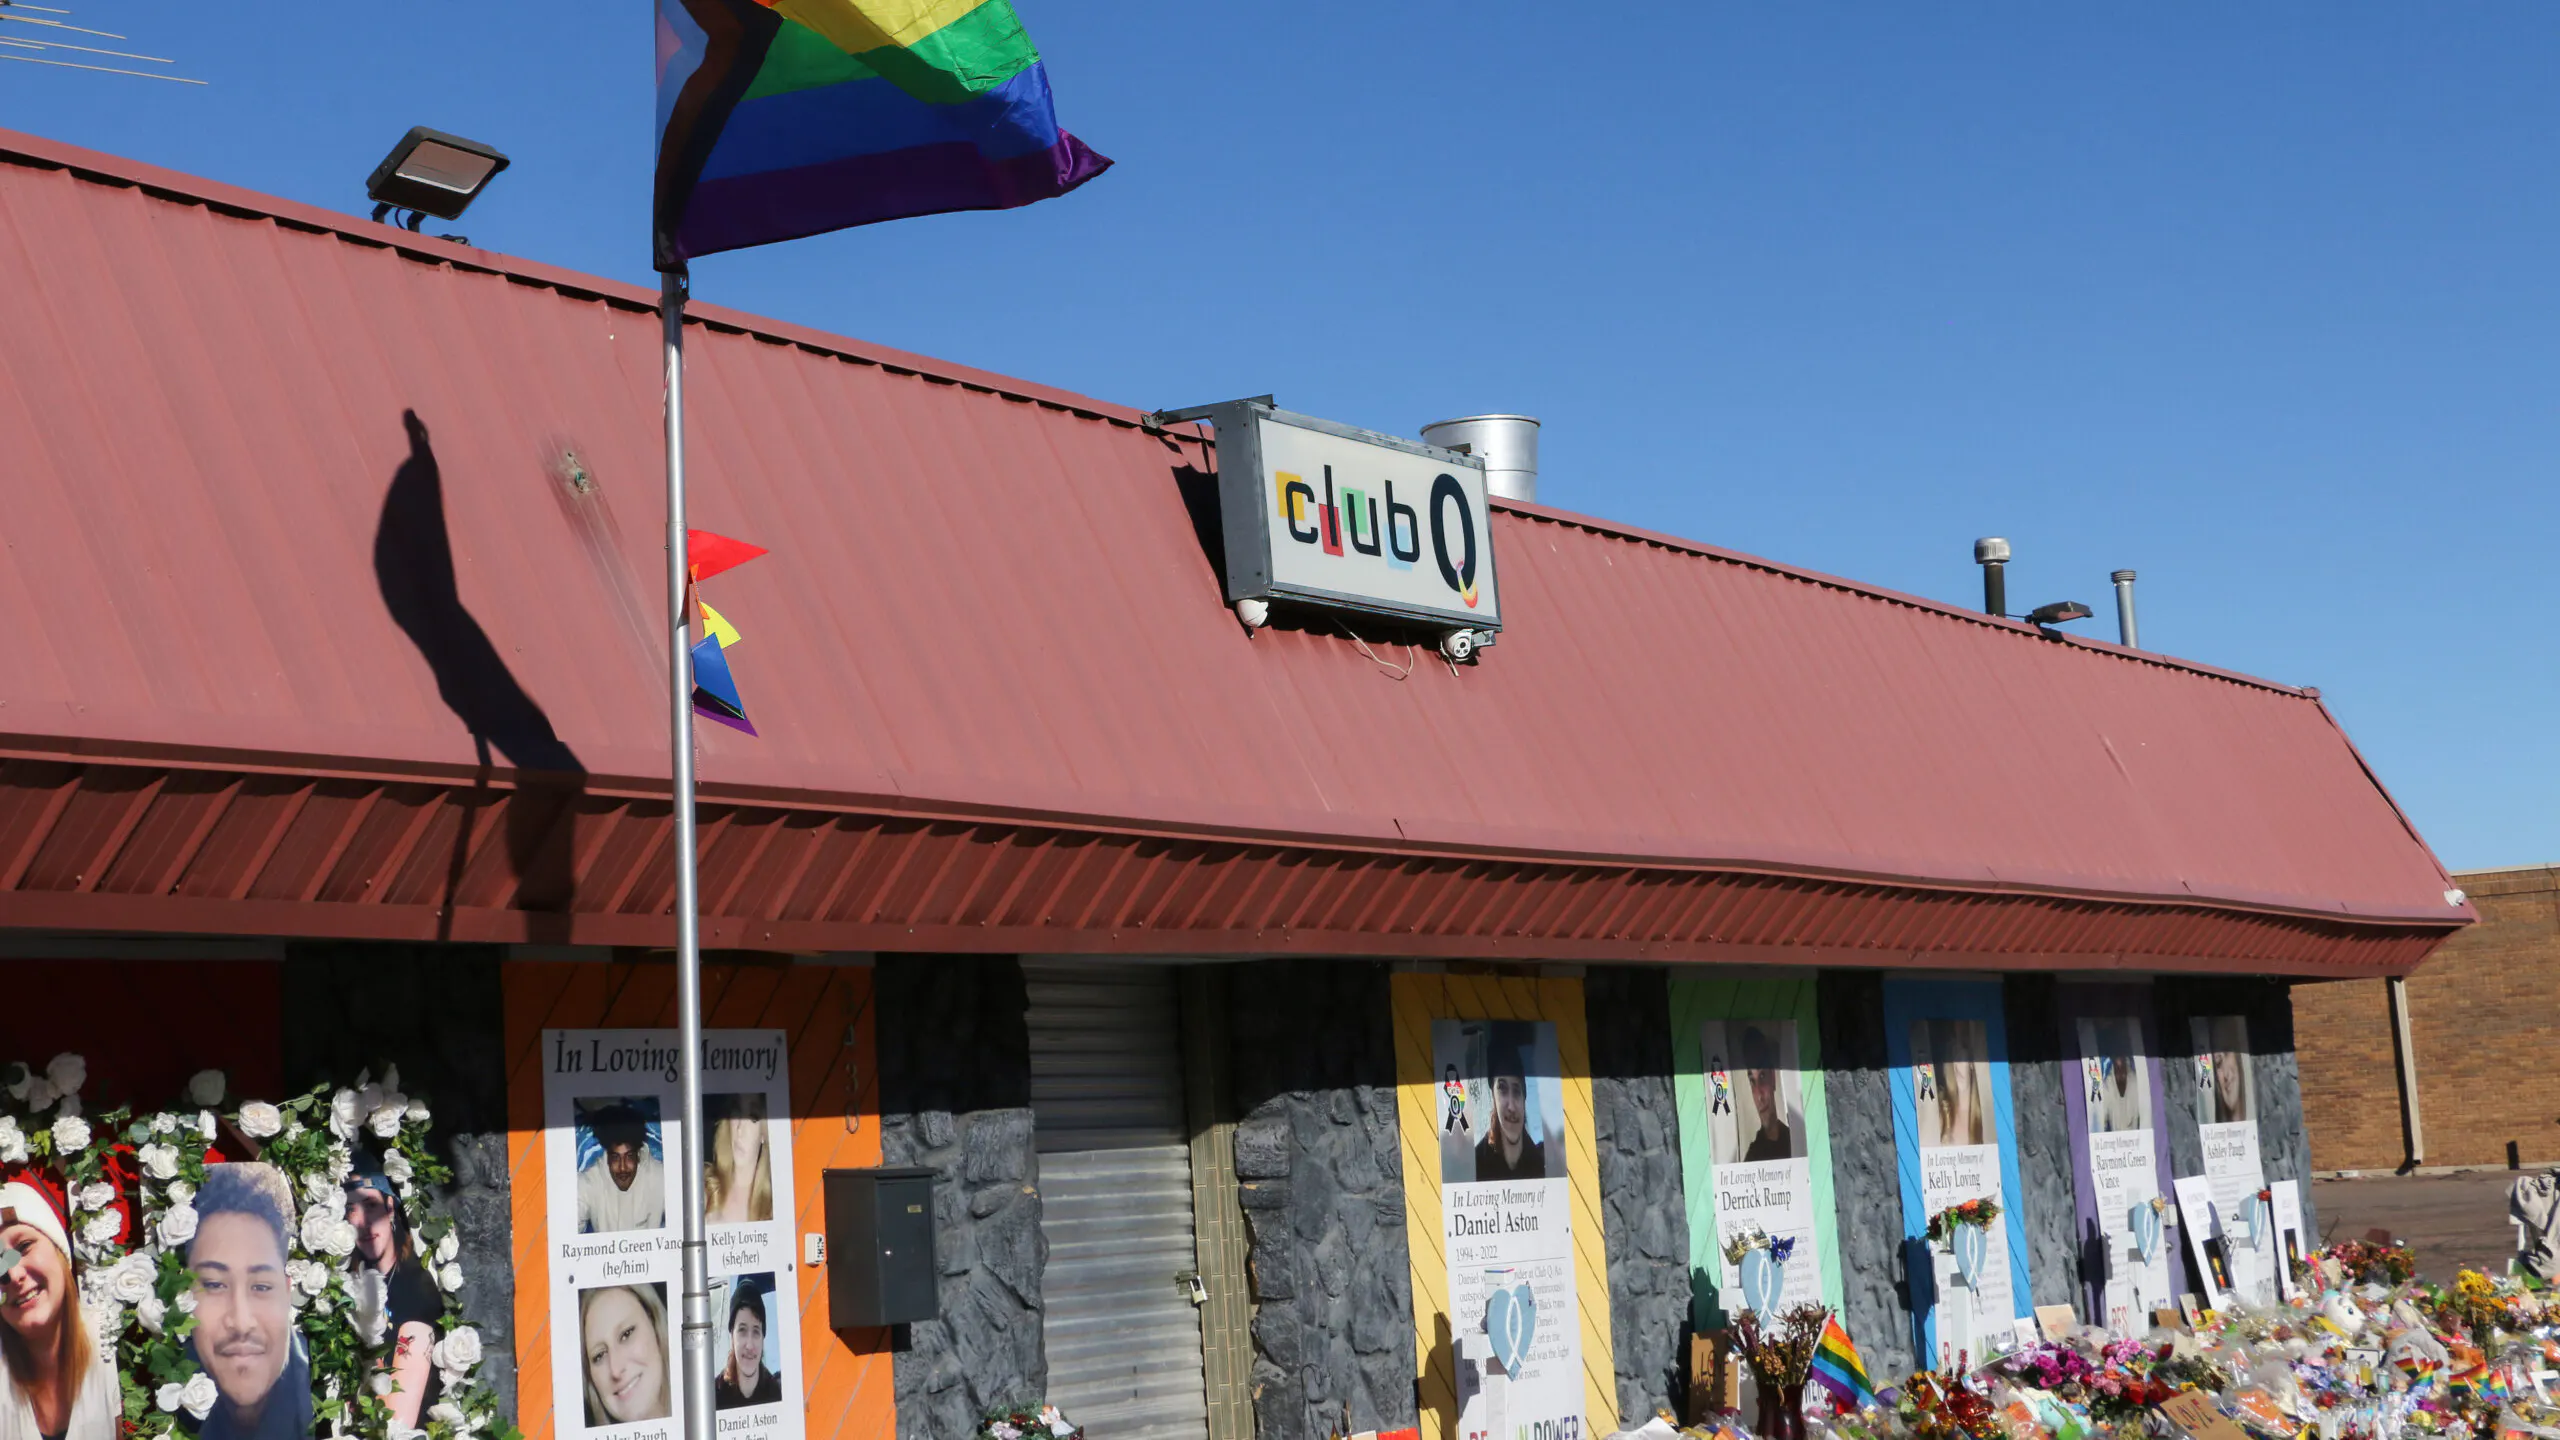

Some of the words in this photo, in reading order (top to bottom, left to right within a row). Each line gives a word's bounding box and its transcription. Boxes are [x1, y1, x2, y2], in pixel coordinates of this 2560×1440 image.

[1285, 464, 1420, 563] club
[1429, 473, 1478, 608] Q
[555, 1038, 583, 1073] In
[590, 1038, 680, 1082] Loving
[2096, 1151, 2127, 1175] Raymond
[2127, 1151, 2147, 1168] Green
[1720, 1171, 1729, 1186] In
[1730, 1168, 1756, 1188] Loving
[1757, 1168, 1784, 1185] Memory
[1928, 1170, 1952, 1194] Kelly
[1954, 1167, 1981, 1191] Loving
[1453, 1191, 1464, 1208] In
[1466, 1190, 1500, 1210] Loving
[1502, 1188, 1536, 1208] Memory
[1537, 1186, 1546, 1207] of
[1722, 1188, 1761, 1211] Derrick
[1763, 1187, 1792, 1211] Rump
[1454, 1211, 1501, 1236] Daniel
[1505, 1211, 1539, 1233] Aston
[562, 1240, 616, 1261] Raymond
[618, 1239, 653, 1255] Green
[655, 1236, 683, 1251] Vanc
[711, 1231, 737, 1249] Kelly
[738, 1230, 769, 1246] Loving
[722, 1250, 760, 1269] (she/her)
[1456, 1247, 1474, 1262] 1994
[1480, 1245, 1498, 1260] 2022
[602, 1260, 649, 1279] (he/him)
[718, 1414, 750, 1432] Daniel
[753, 1413, 778, 1427] Aston
